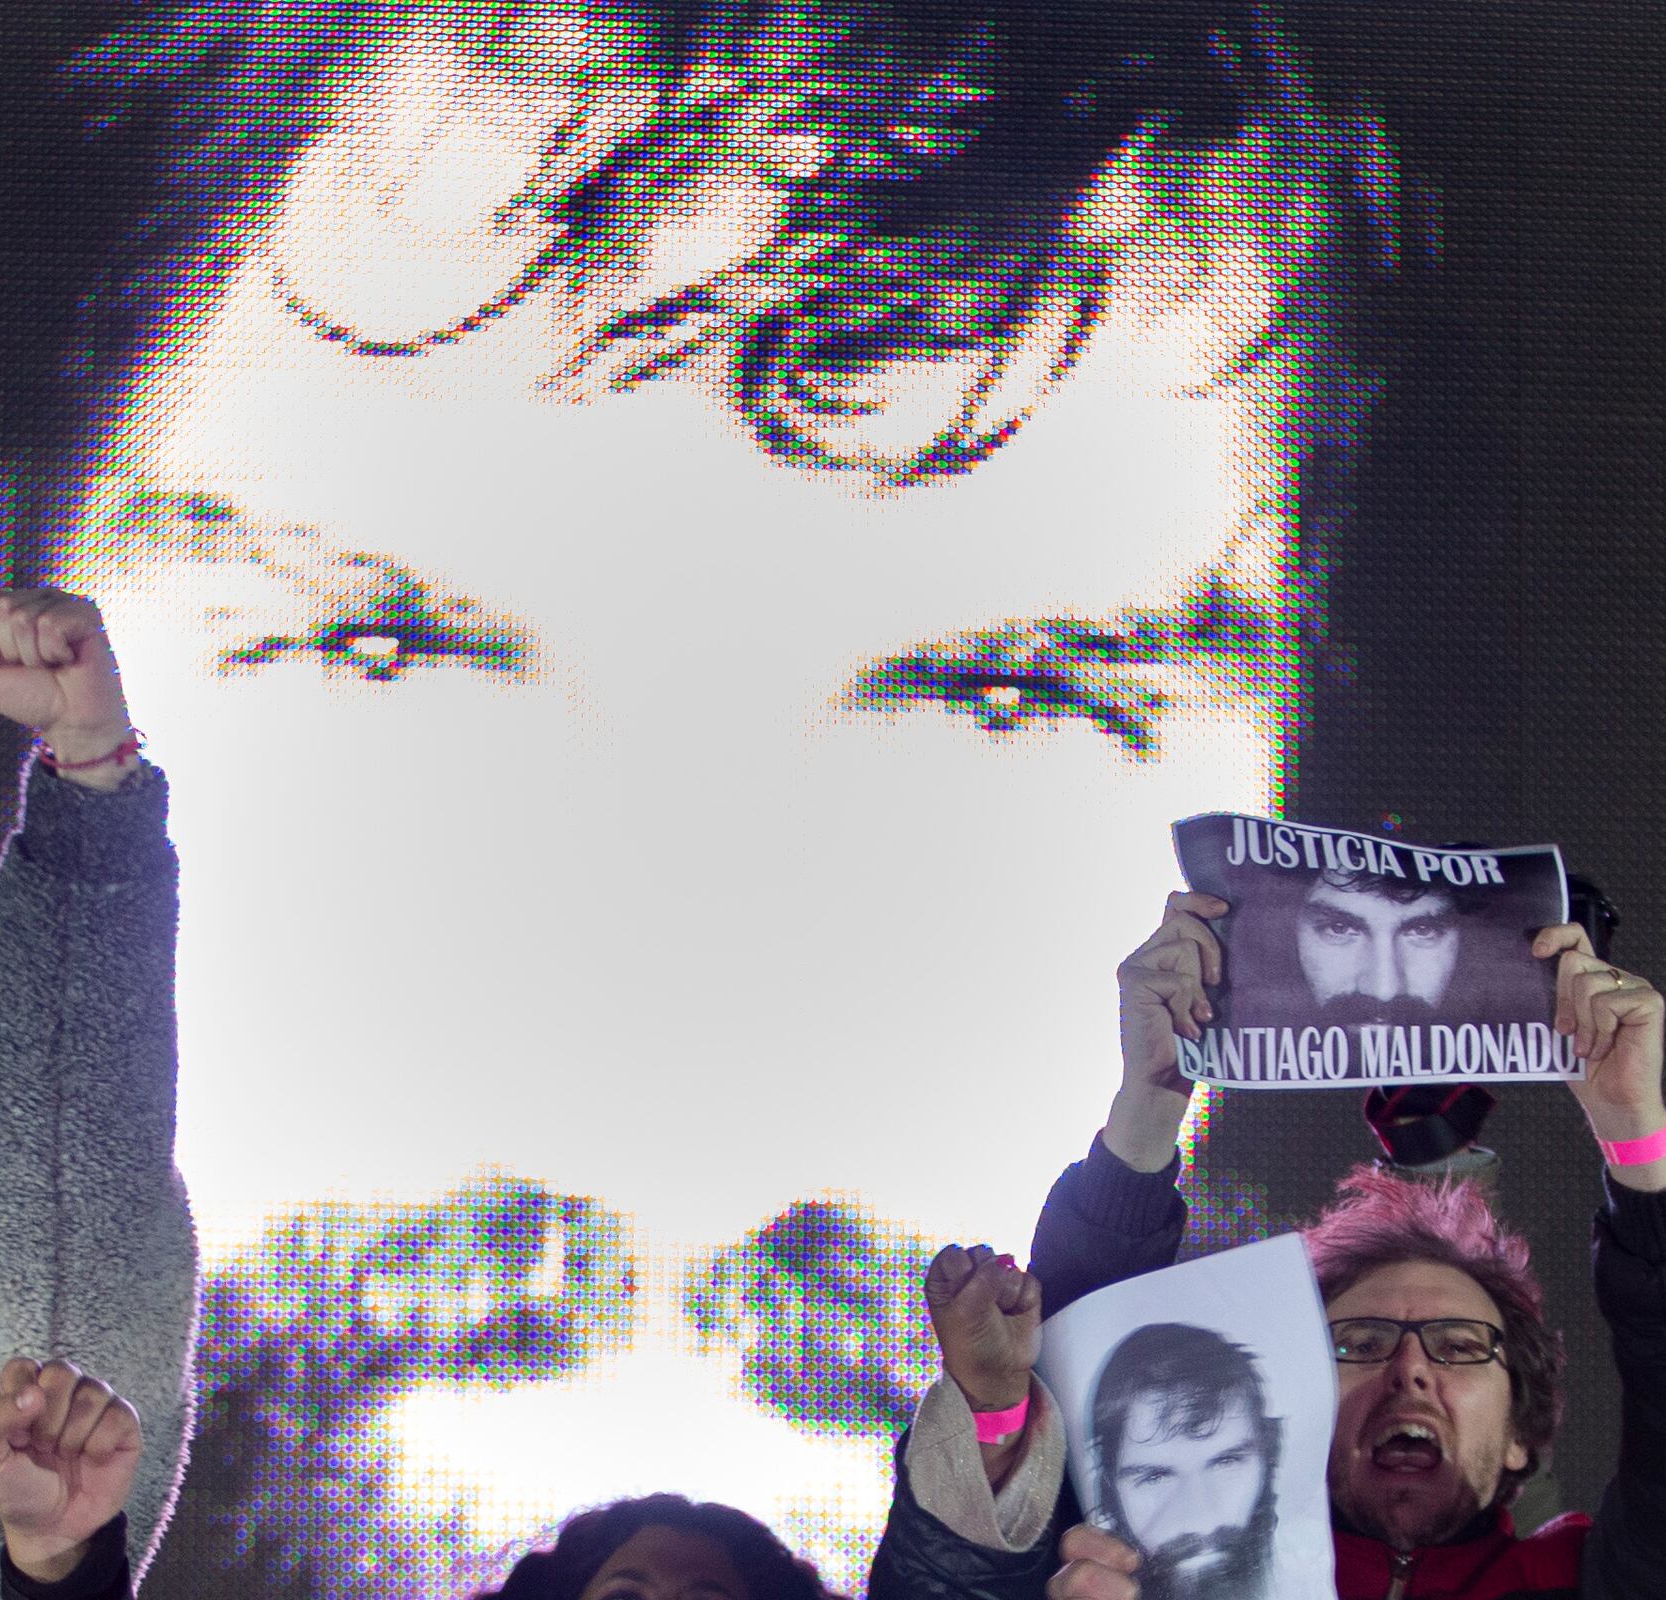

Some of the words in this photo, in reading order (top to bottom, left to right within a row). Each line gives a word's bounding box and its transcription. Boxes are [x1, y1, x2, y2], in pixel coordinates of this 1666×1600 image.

[1227, 818, 1406, 878] JUSTICIA
[1414, 850, 1505, 886] POR
[1184, 1025, 1349, 1081] SANTIAGO
[1361, 1022, 1577, 1080] MALDONADO
